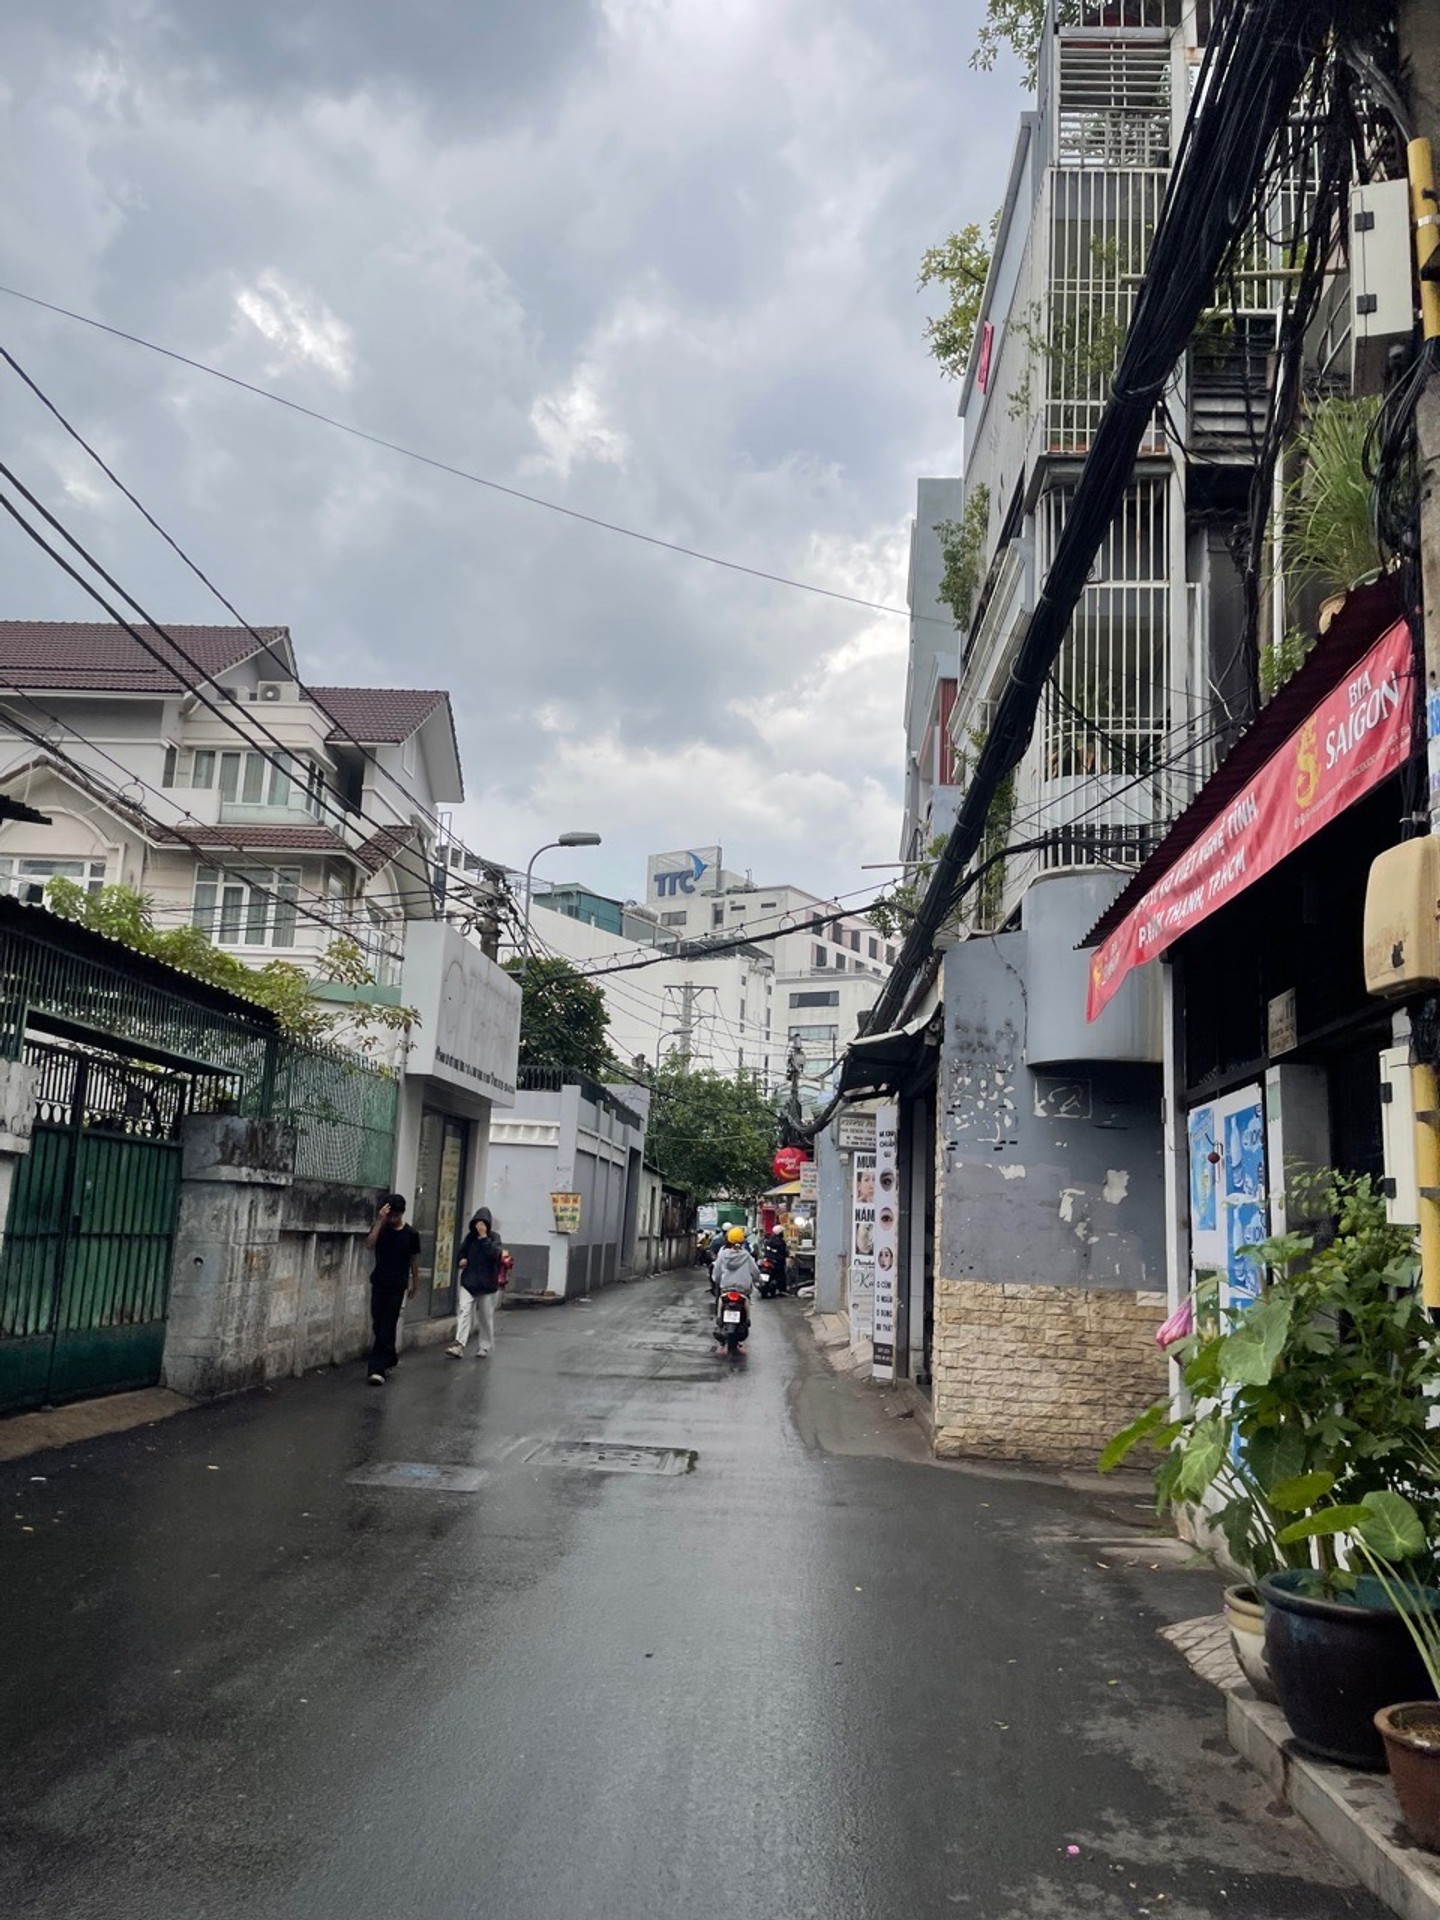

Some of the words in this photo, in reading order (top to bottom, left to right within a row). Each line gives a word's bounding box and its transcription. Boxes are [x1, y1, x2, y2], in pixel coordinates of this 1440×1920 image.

[1348, 670, 1372, 708] BIA
[1325, 670, 1400, 770] SAIGON
[654, 870, 696, 897] TTC
[855, 1206, 875, 1222] NÁM
